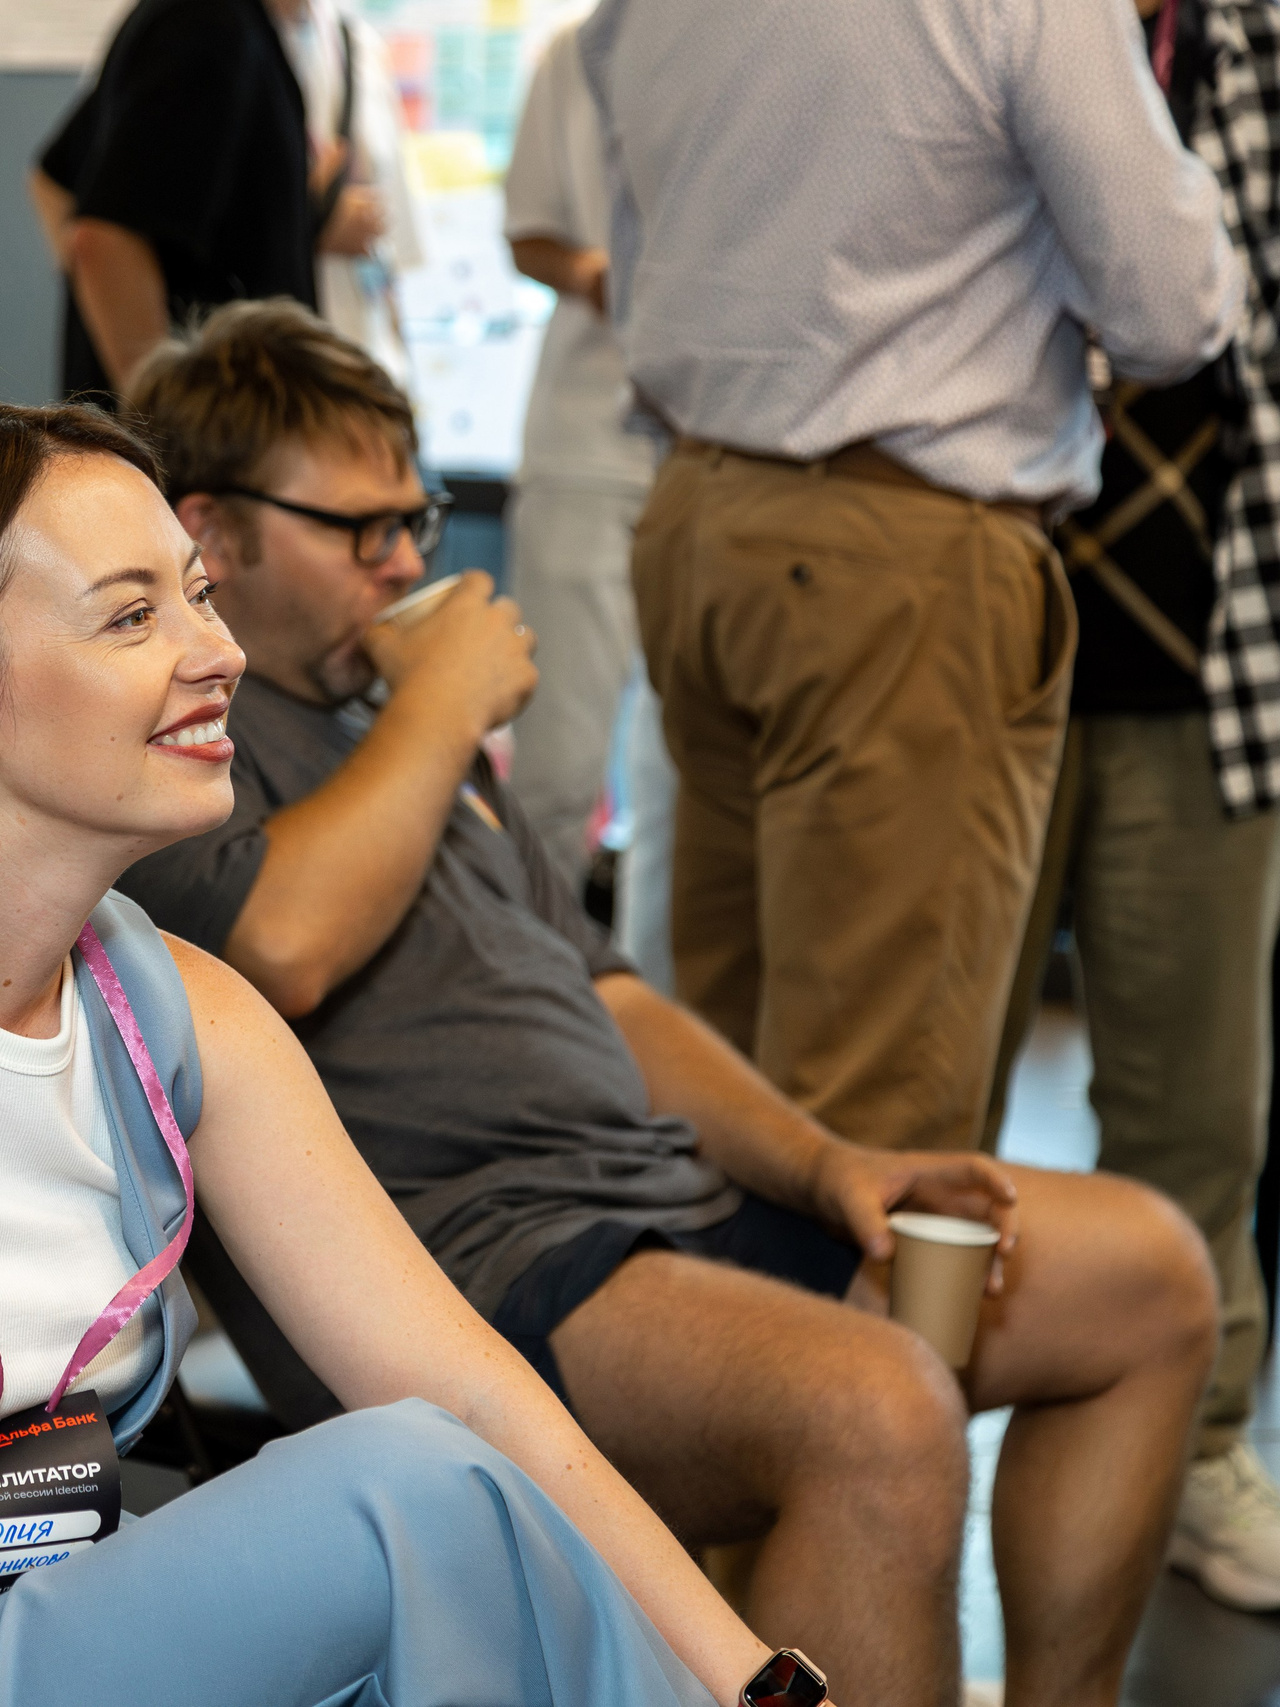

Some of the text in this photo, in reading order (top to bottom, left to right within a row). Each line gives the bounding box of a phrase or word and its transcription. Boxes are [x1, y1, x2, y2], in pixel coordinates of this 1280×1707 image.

[52, 1412, 98, 1430] Банк
[13, 1488, 54, 1500] сессии
[55, 1484, 99, 1496] Ideation
